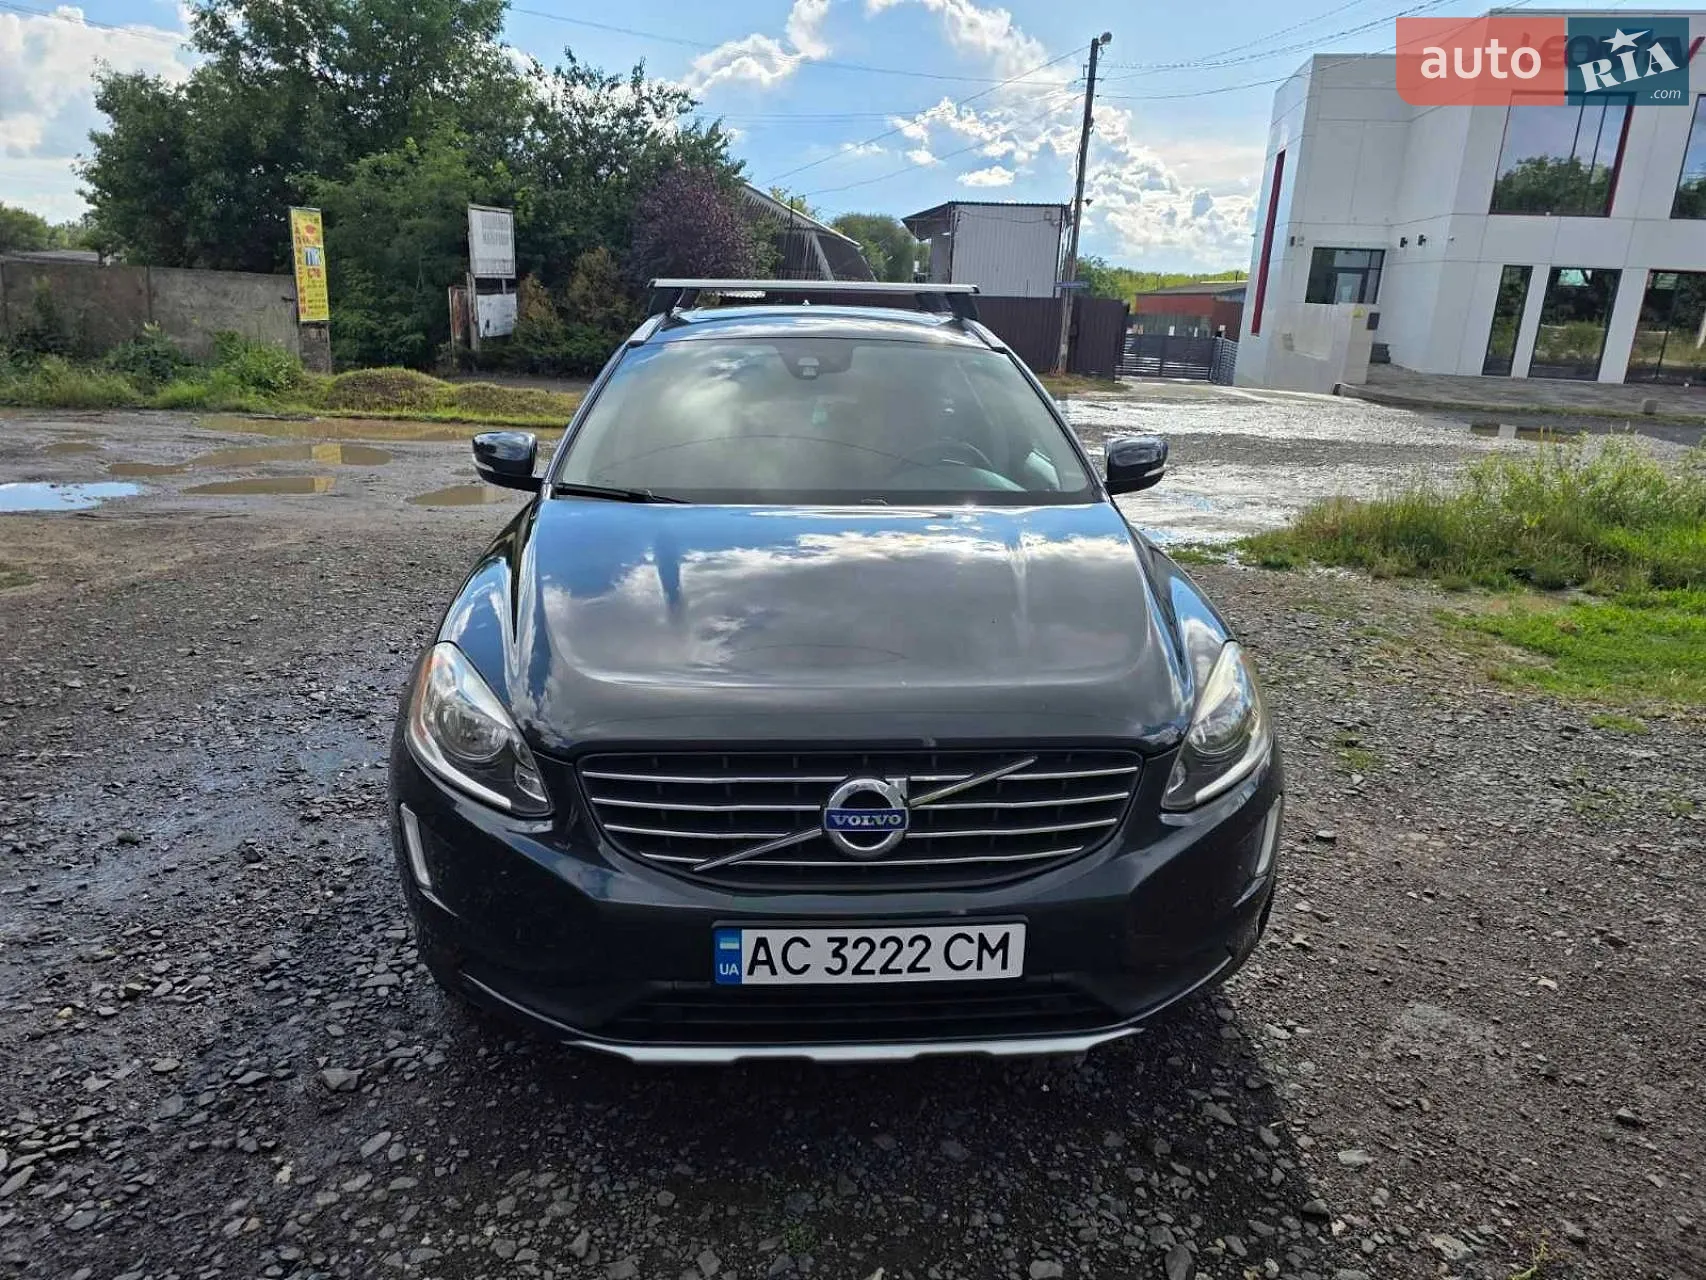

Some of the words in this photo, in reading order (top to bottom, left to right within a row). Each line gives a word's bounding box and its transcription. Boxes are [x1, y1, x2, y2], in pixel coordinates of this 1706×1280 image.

[831, 814, 902, 826] VOLVO
[747, 936, 811, 976] AC
[824, 934, 932, 976] 3222
[943, 932, 1011, 972] CM
[719, 963, 740, 976] UA
